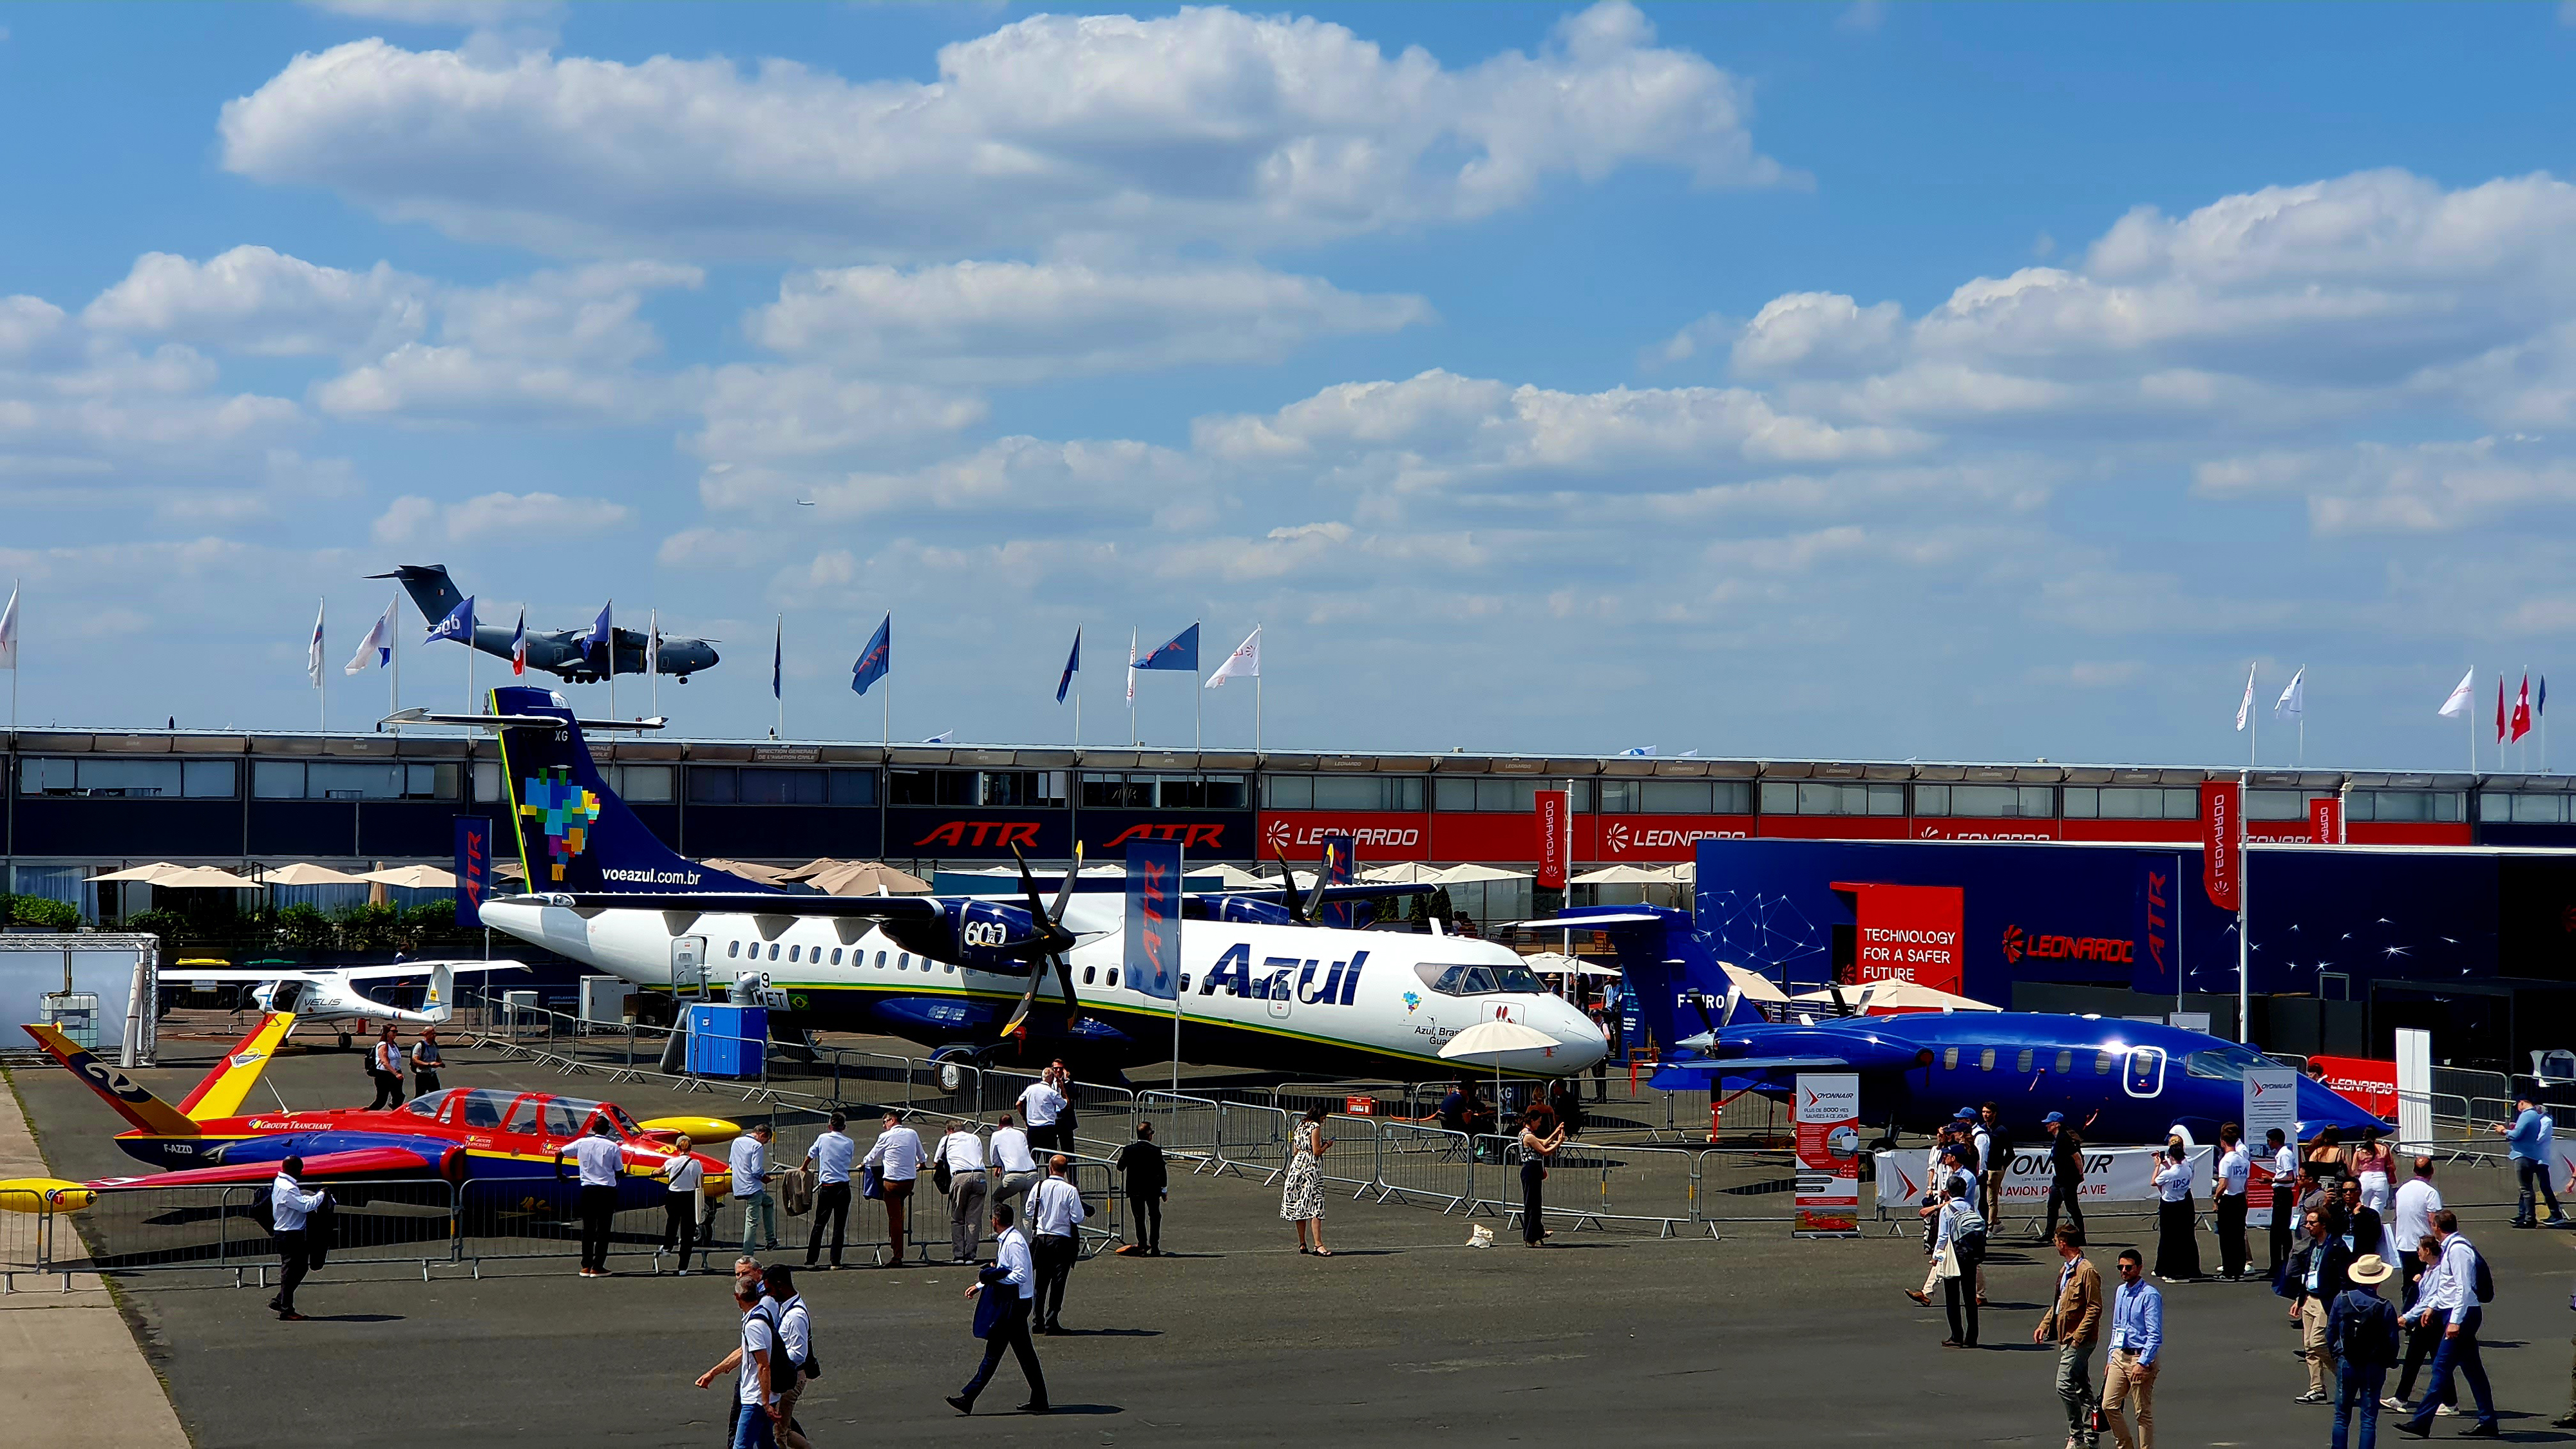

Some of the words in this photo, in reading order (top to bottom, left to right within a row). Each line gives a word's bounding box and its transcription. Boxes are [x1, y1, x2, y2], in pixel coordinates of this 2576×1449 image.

[555, 730, 568, 742] XG
[914, 821, 1041, 848] ATR
[468, 831, 482, 909] ATR
[602, 867, 701, 886] voeazul.com.br
[1143, 860, 1166, 976] ATR
[2148, 871, 2166, 974] ATR
[1864, 928, 1956, 945] TECHNOLOGY
[1863, 947, 1889, 961] FOR
[1894, 949, 1904, 961] A
[1908, 949, 1951, 964] SAFER
[1198, 942, 1370, 1007] Azul
[1863, 966, 1915, 981] FUTURE
[2330, 1077, 2393, 1095] LEONARDO
[164, 1144, 193, 1154] F-AZZD
[2005, 1185, 2039, 1197] AVION
[2090, 1184, 2107, 1195] VIE
